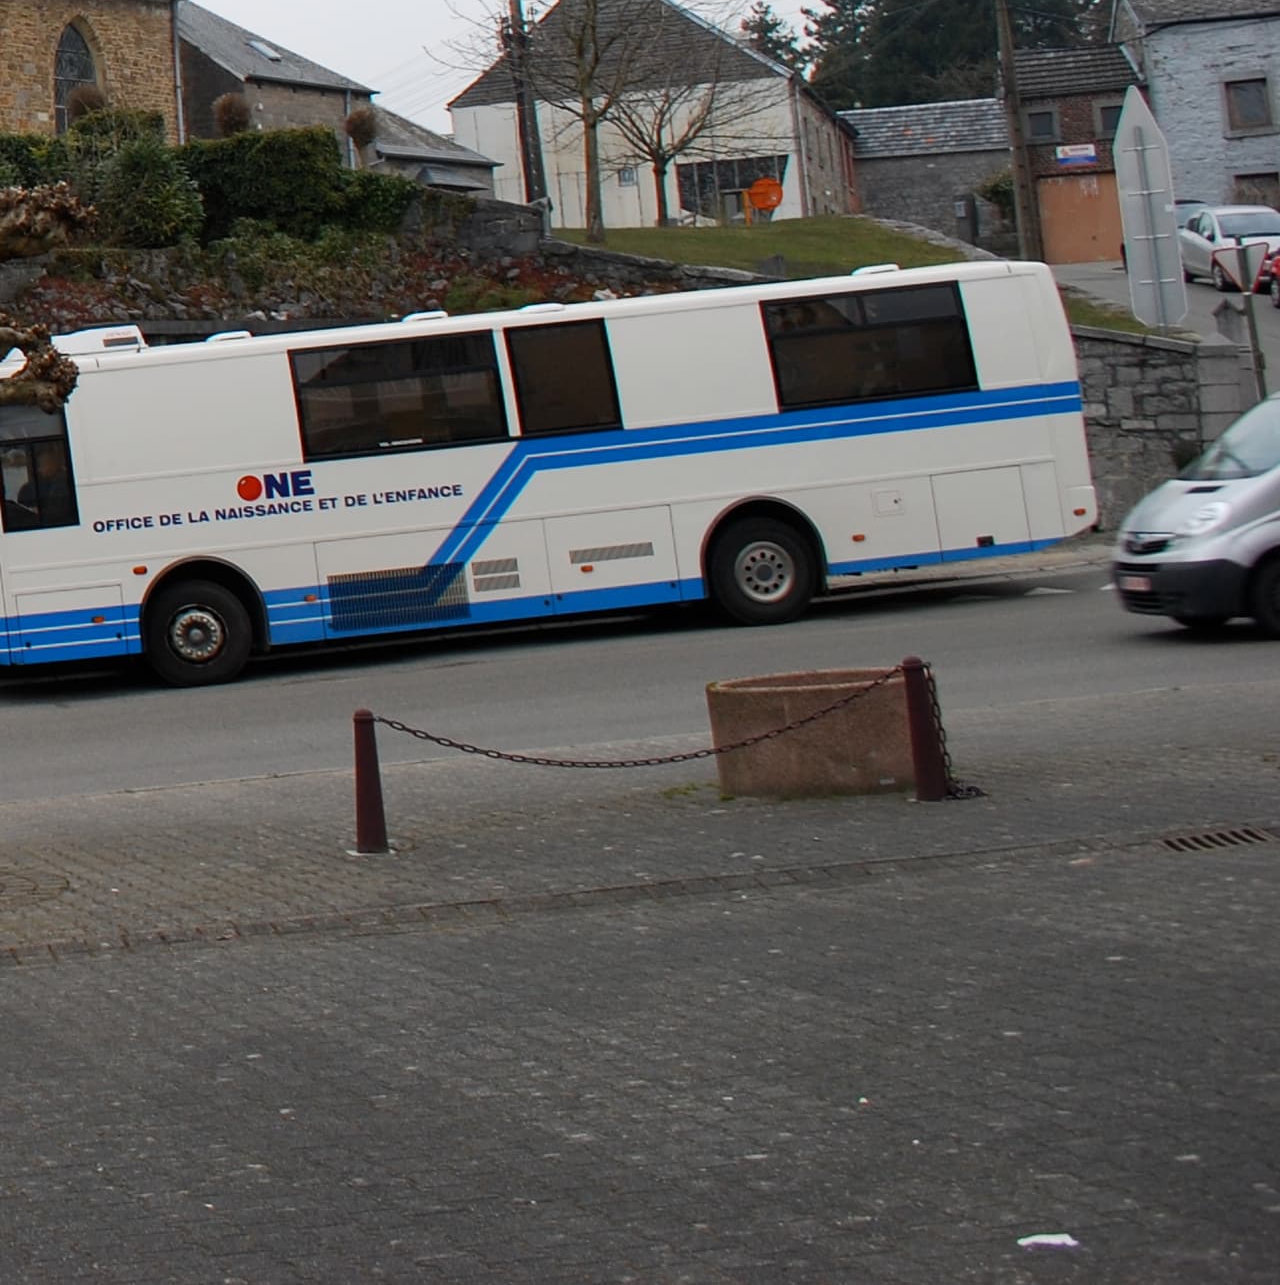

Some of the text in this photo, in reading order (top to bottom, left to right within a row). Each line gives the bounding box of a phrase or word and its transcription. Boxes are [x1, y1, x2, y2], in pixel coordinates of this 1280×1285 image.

[92, 484, 463, 533] OFFICE DE LA NAISSANCE ET DE L'ENFANCE
